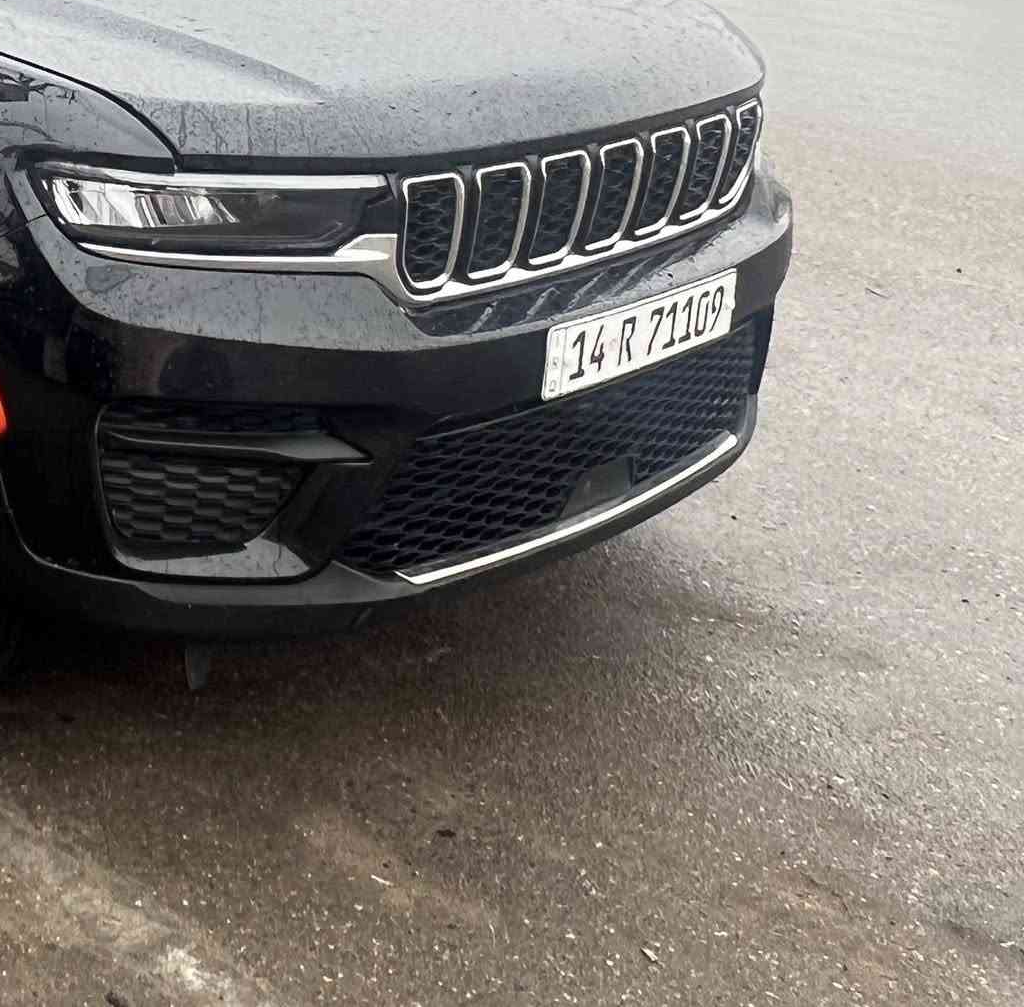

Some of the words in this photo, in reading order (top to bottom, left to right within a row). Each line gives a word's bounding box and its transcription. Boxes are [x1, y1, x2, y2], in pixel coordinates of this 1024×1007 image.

[569, 324, 604, 380] 14
[617, 315, 637, 366] R
[646, 285, 725, 356] 71109
